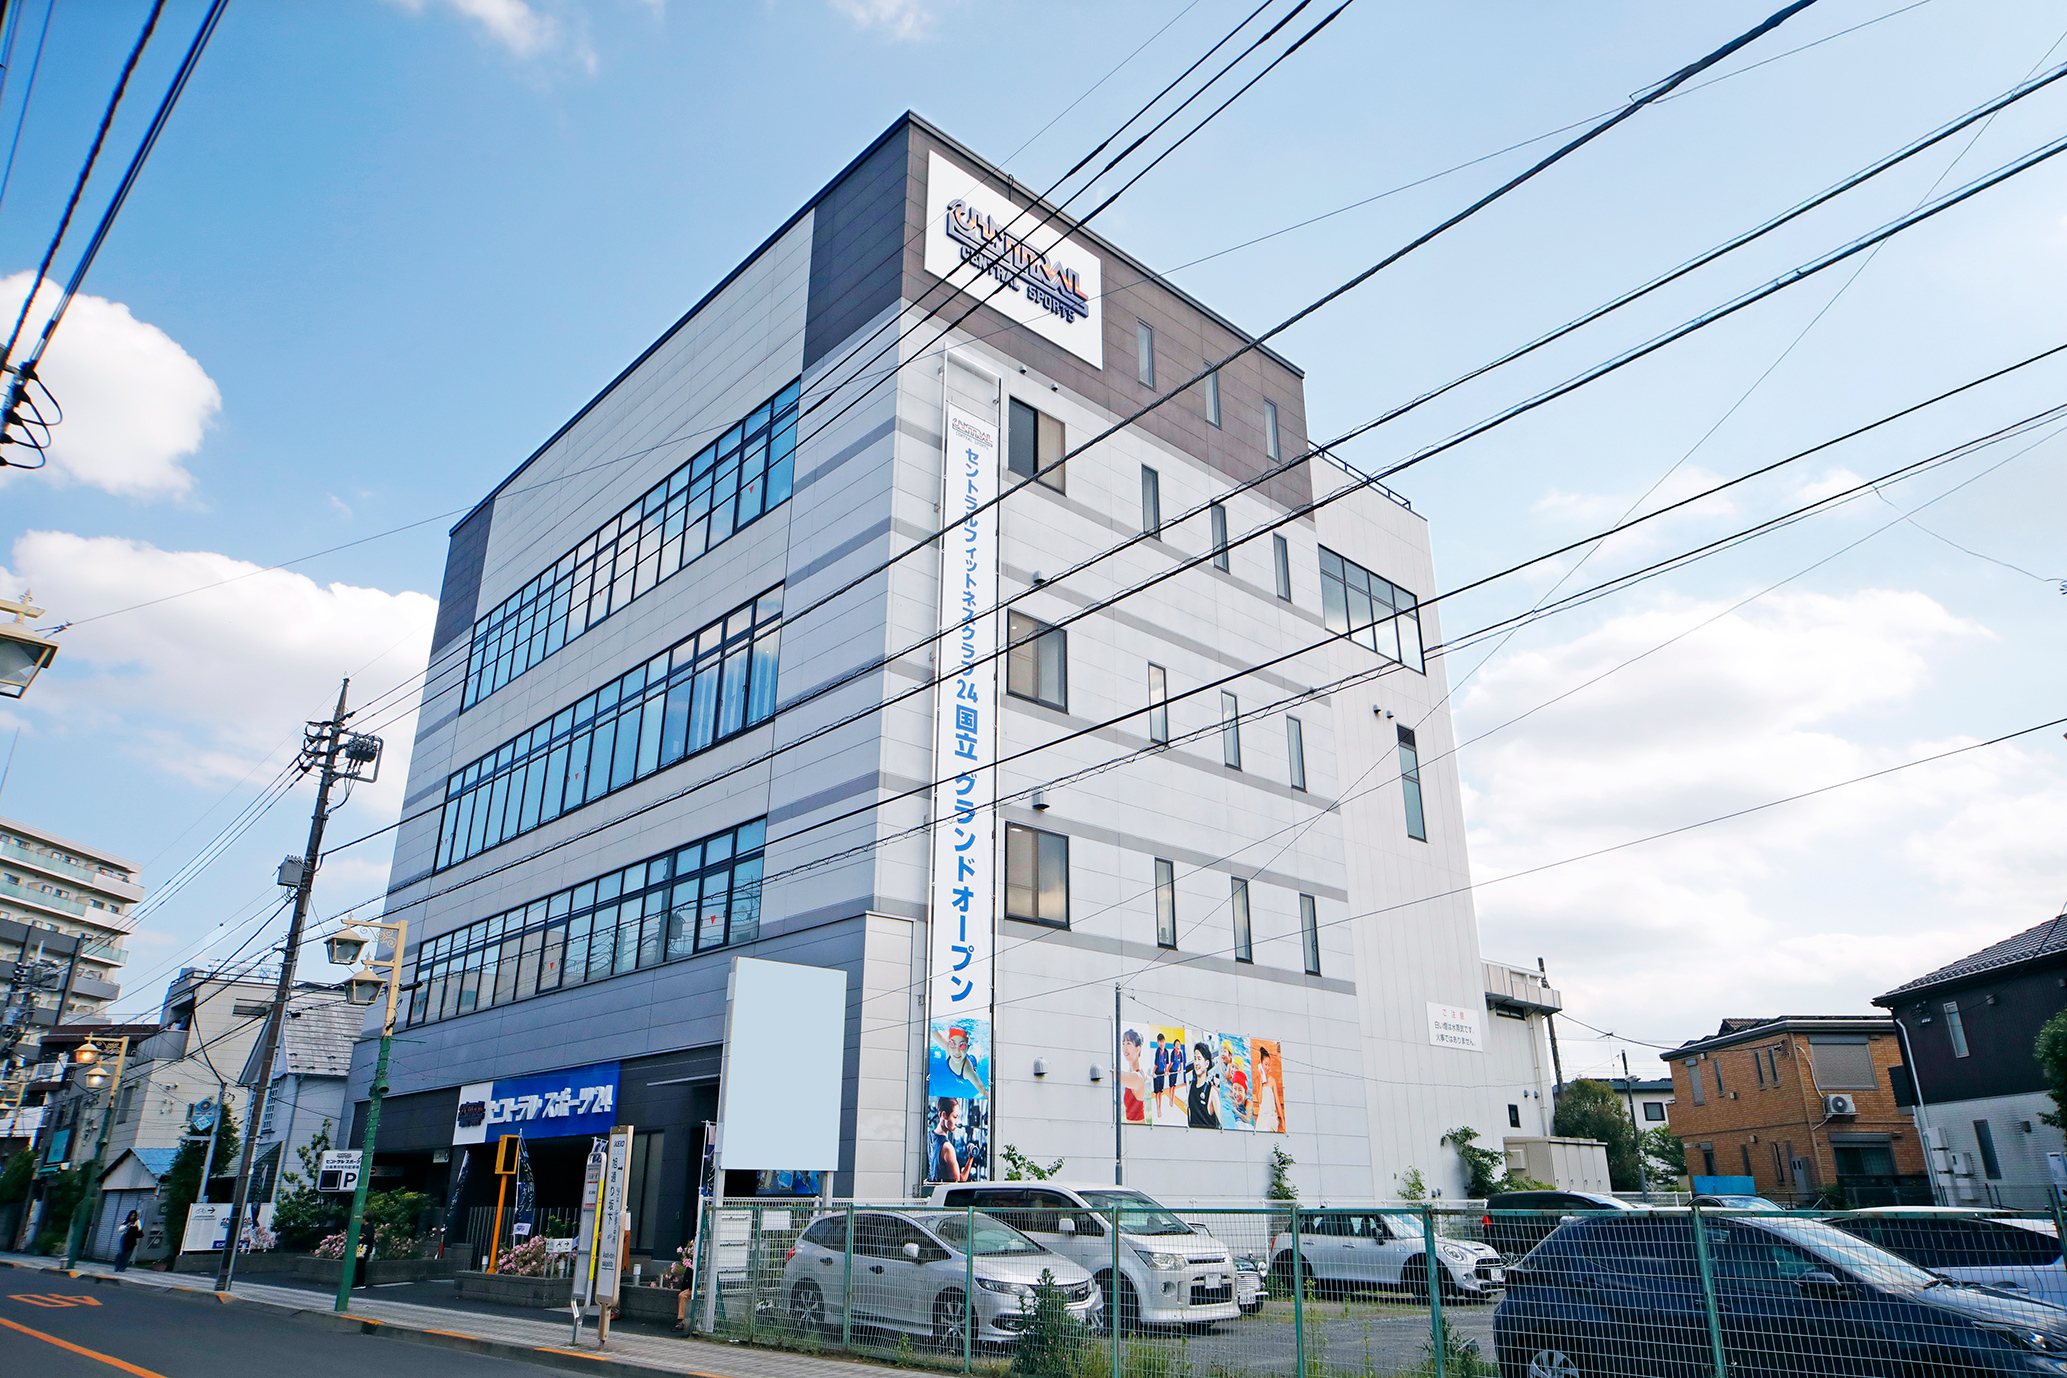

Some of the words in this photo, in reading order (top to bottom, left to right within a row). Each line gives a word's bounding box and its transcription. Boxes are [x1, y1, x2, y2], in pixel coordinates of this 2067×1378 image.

[960, 245, 1020, 292] CENTRAL
[1027, 285, 1075, 323] SPORTS
[343, 1172, 357, 1188] P
